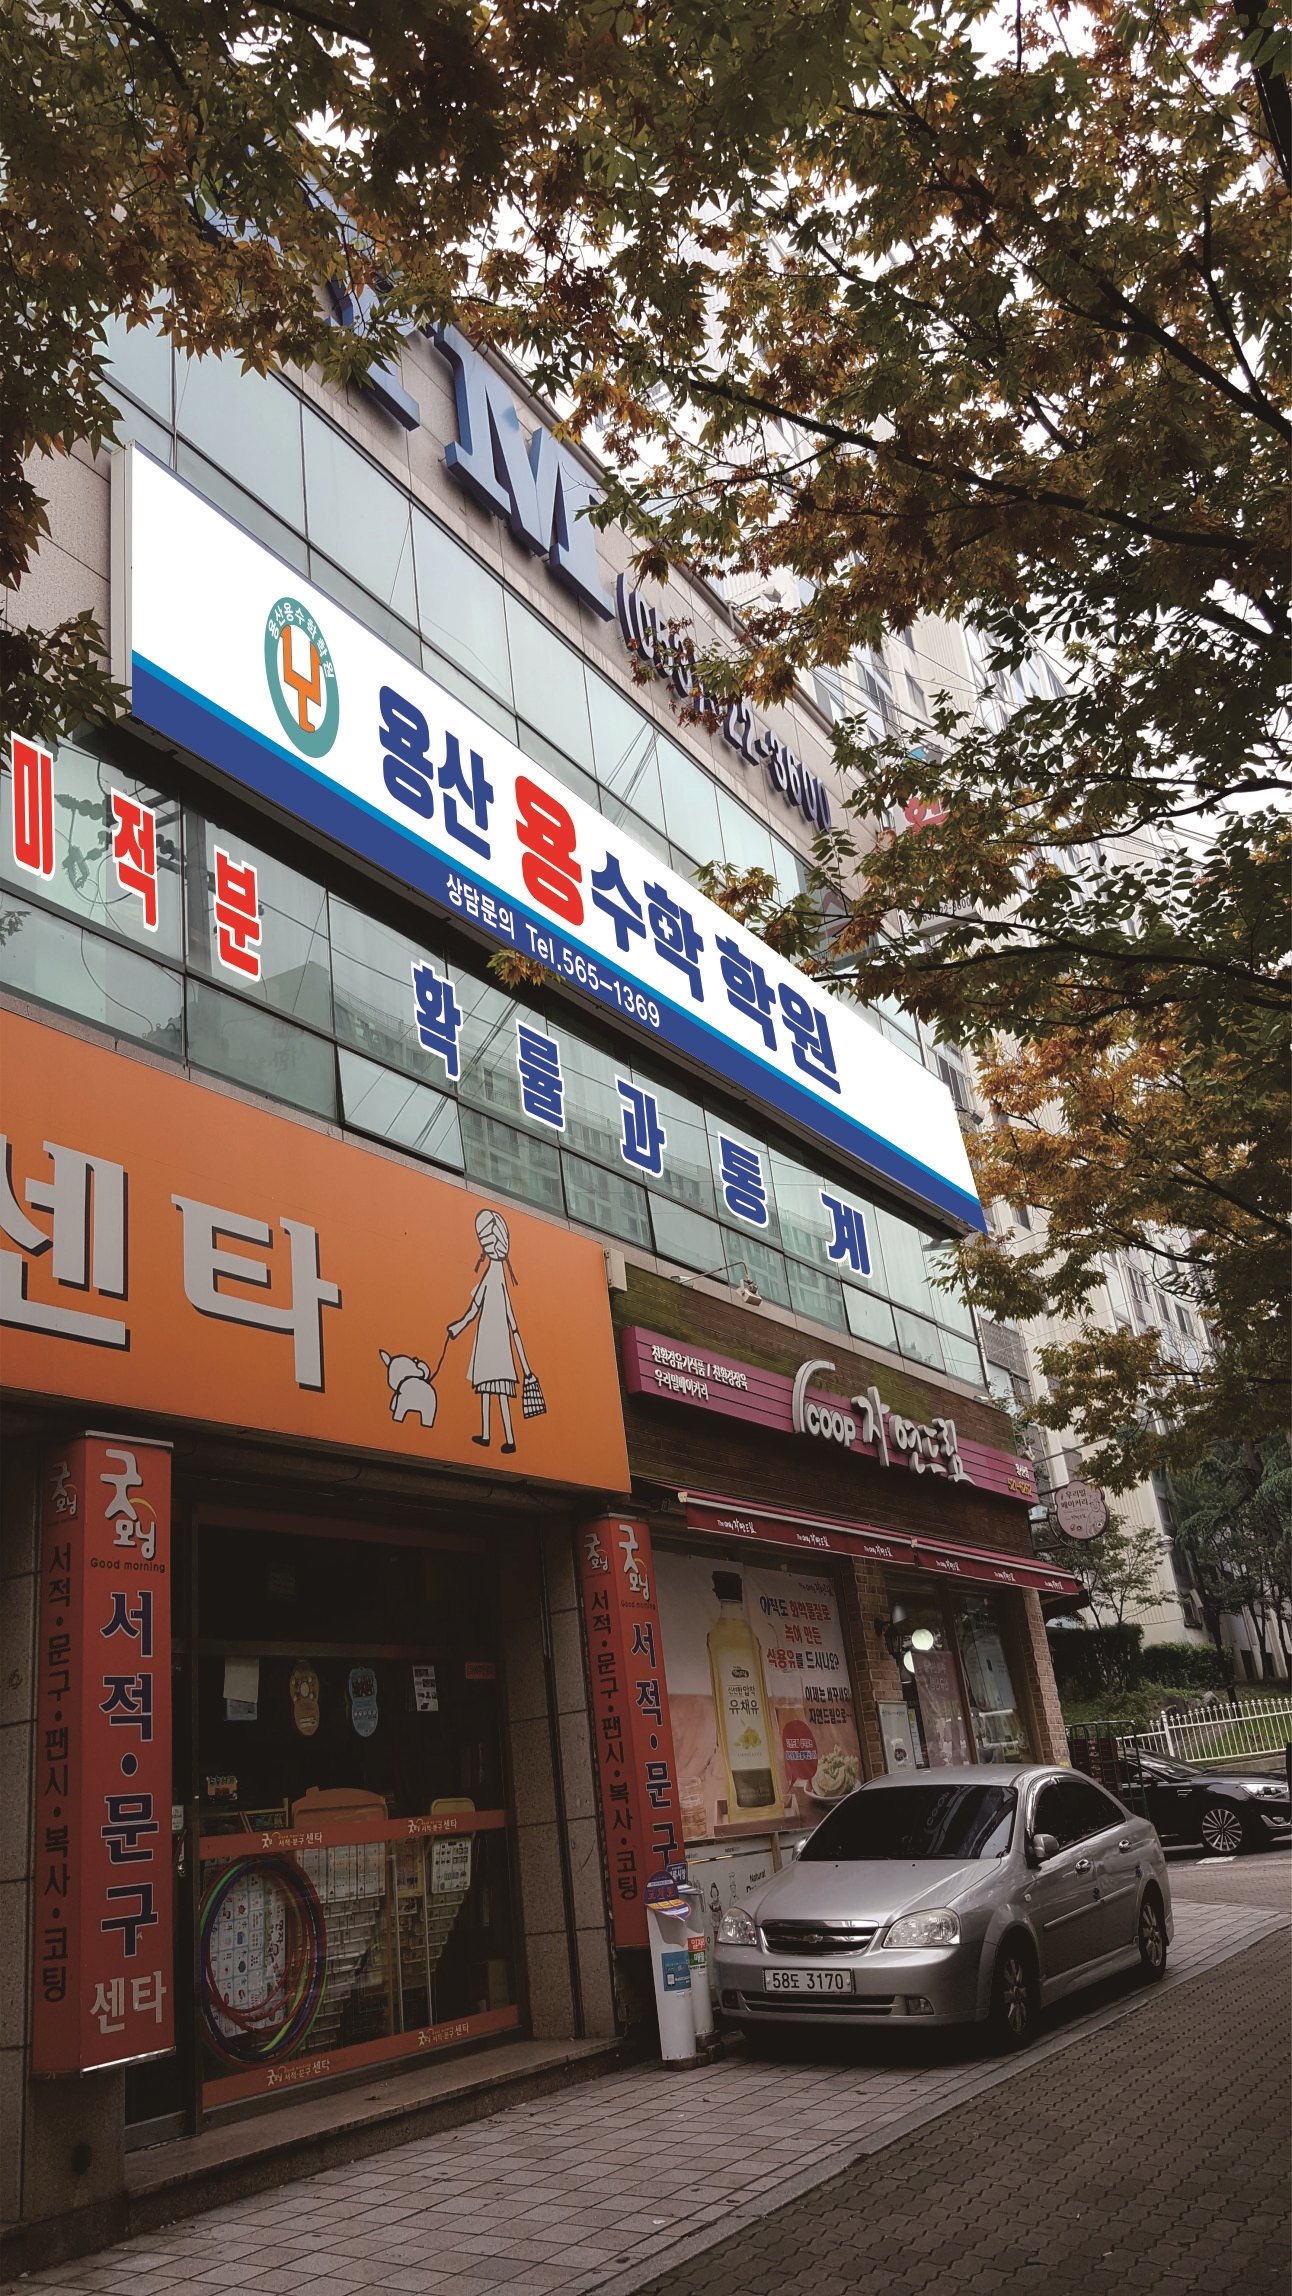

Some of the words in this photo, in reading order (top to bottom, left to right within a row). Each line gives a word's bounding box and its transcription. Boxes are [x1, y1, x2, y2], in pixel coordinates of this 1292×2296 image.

[616, 572, 832, 836] (053)22-3600
[379, 685, 494, 860] 용산
[715, 930, 841, 1094] 학원
[446, 873, 516, 941] 상담문의
[0, 1133, 343, 1394] 센타
[654, 1368, 709, 1401] 우리밀베이커리
[804, 1401, 857, 1448] COOP
[850, 1385, 977, 1488] 자연드림
[99, 1448, 157, 1561] 굿모닝
[90, 1557, 121, 1570] Good
[124, 1560, 166, 1574] morning
[618, 1524, 651, 1601] 굿모닝
[759, 1596, 789, 1617] 아직도
[766, 1647, 804, 1669] 식용유를
[728, 1699, 760, 1716] 유채유
[89, 1970, 168, 2036] 센타
[772, 1972, 800, 1989] 58도
[806, 1972, 845, 1990] 3170
